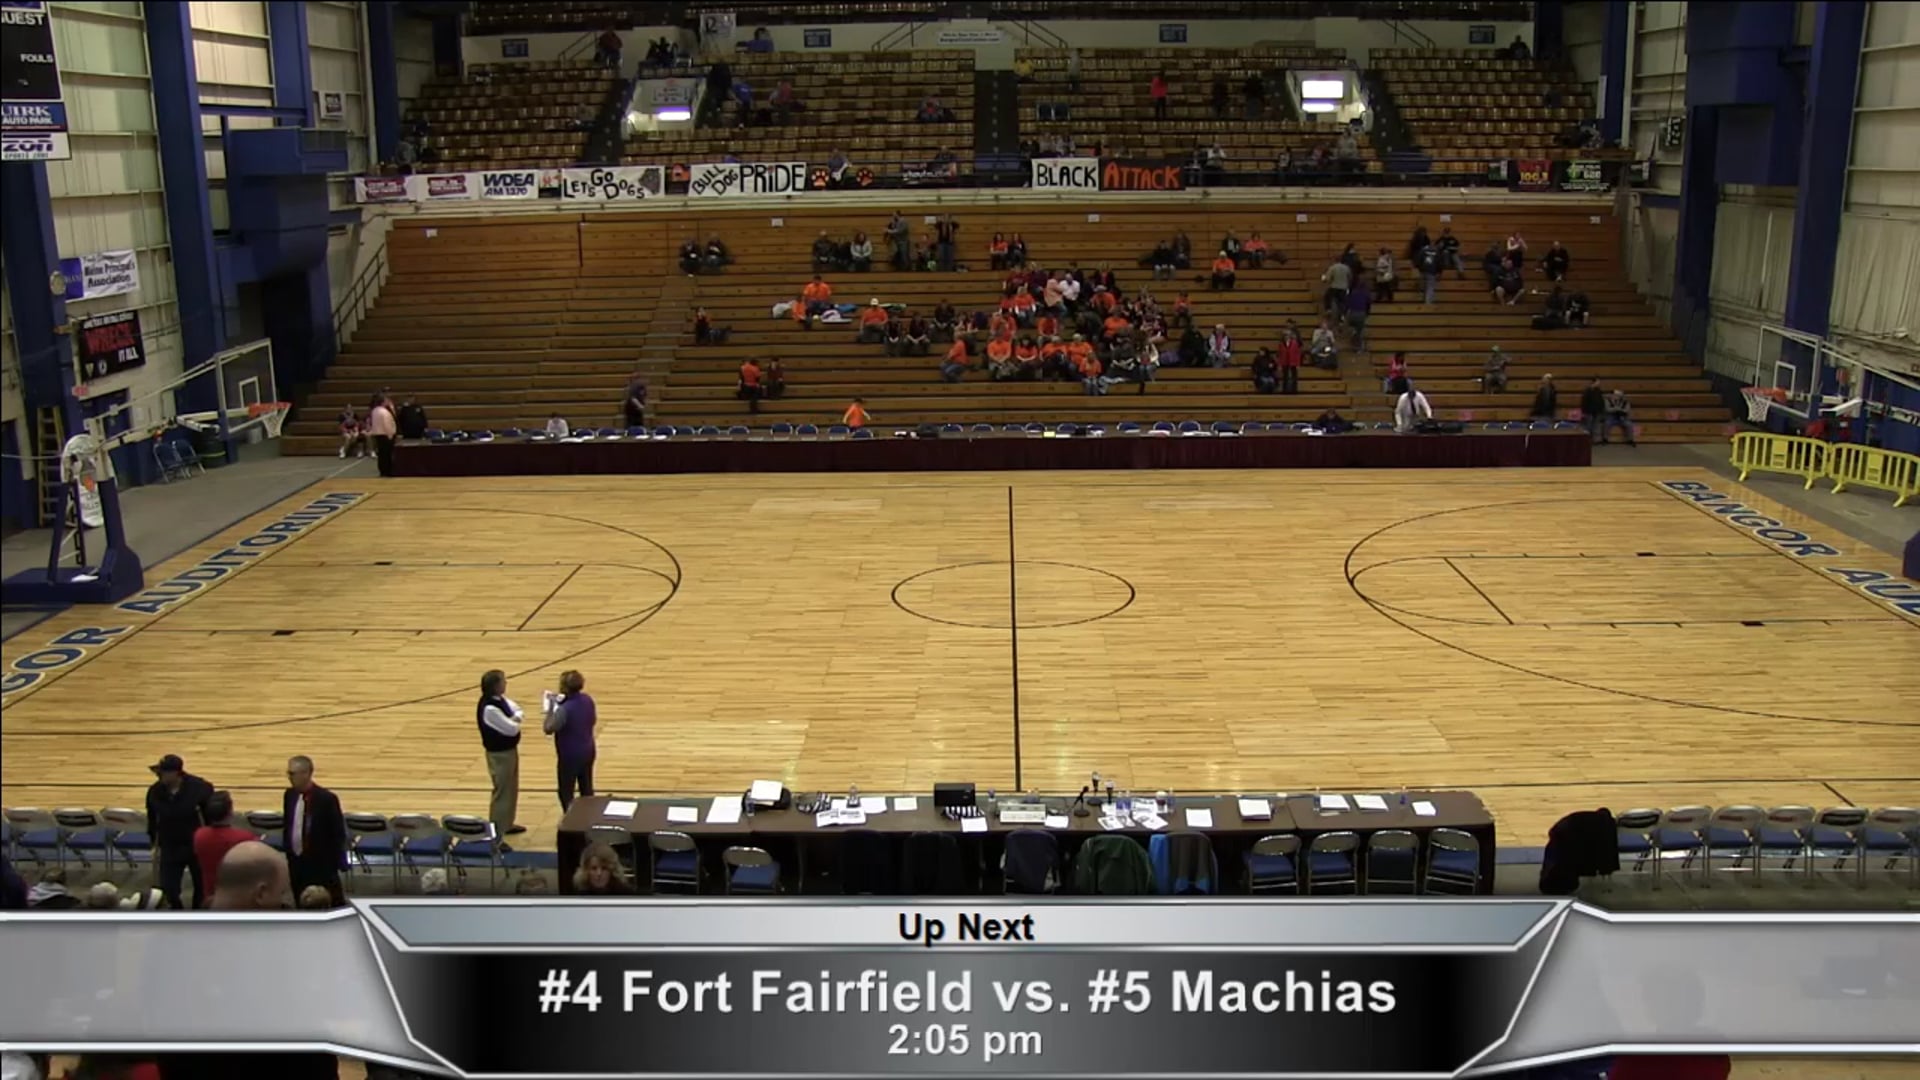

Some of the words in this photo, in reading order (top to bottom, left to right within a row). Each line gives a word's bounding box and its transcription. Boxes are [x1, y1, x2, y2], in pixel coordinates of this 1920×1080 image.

[1, 12, 45, 25] UEST
[20, 53, 53, 63] FOULS
[483, 173, 535, 187] WDEA
[692, 165, 726, 195] BULL
[711, 169, 739, 196] DOG
[1037, 163, 1097, 187] BLACK
[1104, 161, 1181, 190] ATTACK
[484, 187, 504, 196] AM
[1657, 480, 1842, 559] BANGOR
[115, 492, 372, 615] AUDITORIUM
